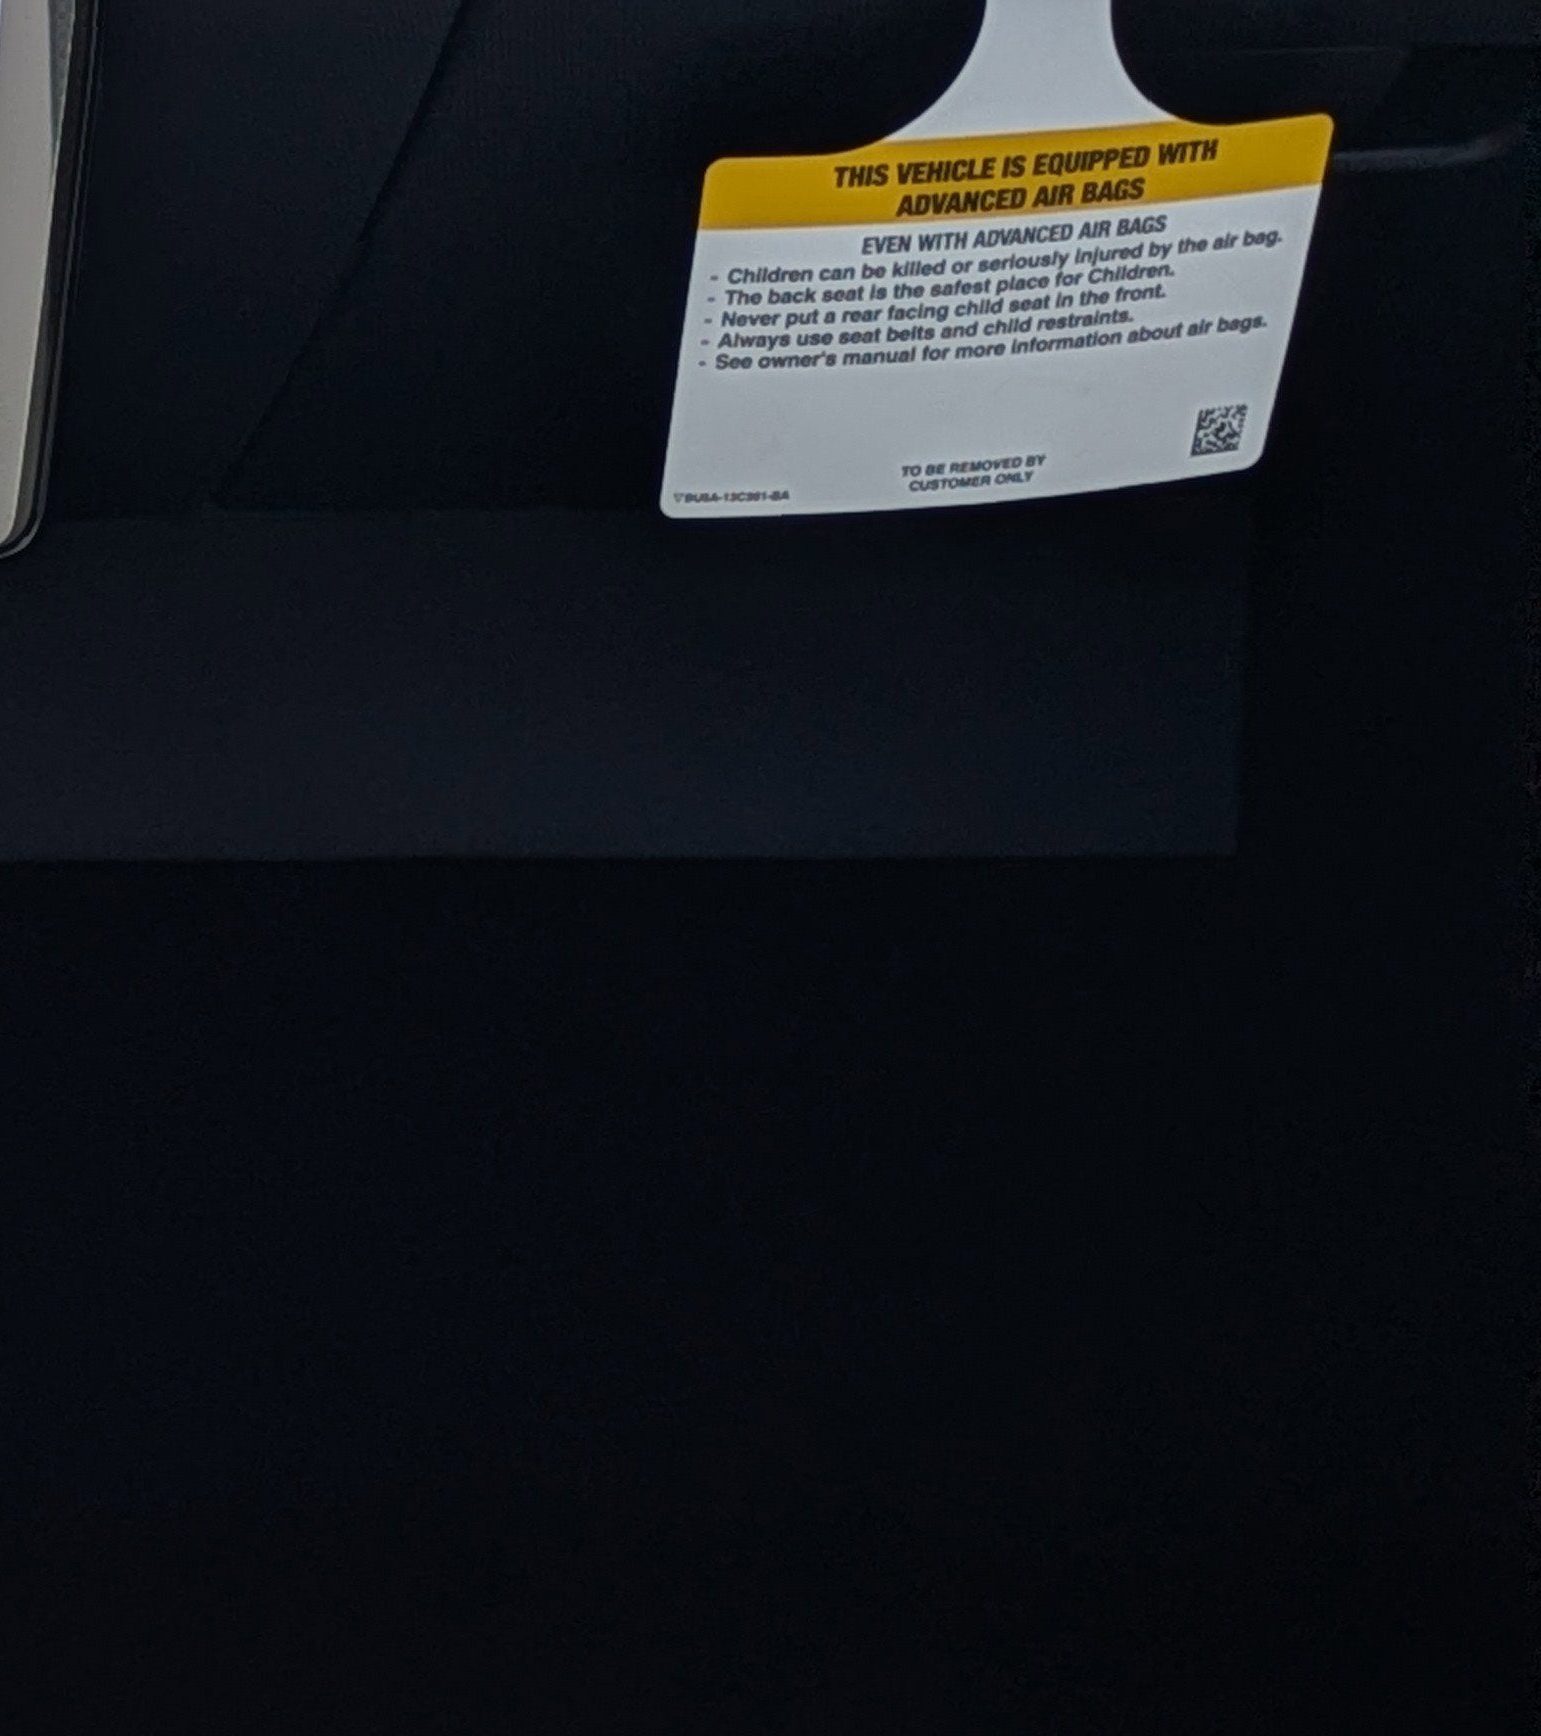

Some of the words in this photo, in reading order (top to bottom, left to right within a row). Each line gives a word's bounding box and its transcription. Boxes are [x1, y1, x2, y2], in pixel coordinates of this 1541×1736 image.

[834, 163, 889, 188] THIS
[897, 157, 997, 184] VEHICLE
[1002, 155, 1026, 178] IS
[1032, 145, 1151, 176] EQUIPPED
[1158, 139, 1219, 165] WITH
[896, 188, 1027, 217] ADVANCED
[1032, 183, 1075, 207] AIR
[1081, 177, 1145, 203] BAGS
[862, 235, 912, 255] EVEN
[918, 231, 969, 251] WITH
[973, 222, 1074, 248] ADVANCED
[1078, 220, 1111, 240] AIR
[1116, 215, 1167, 237] BAGS
[727, 267, 813, 285] Children
[819, 266, 855, 281] can
[861, 263, 886, 279] be
[892, 258, 946, 277] killed
[951, 260, 973, 274] or
[978, 250, 1069, 273] seriously
[1074, 242, 1143, 266] injured
[1148, 241, 1172, 259] by
[1178, 236, 1208, 254] the
[1213, 233, 1238, 251] air
[1242, 229, 1282, 248] bag.
[721, 311, 781, 327] Never
[784, 309, 818, 328] put
[824, 310, 836, 324] a
[841, 309, 882, 323] rear
[887, 304, 949, 322] facing
[954, 298, 1004, 317] child
[1009, 294, 1050, 313] seat
[1055, 292, 1074, 308] in
[1079, 289, 1110, 307] the
[1114, 283, 1165, 303] front.
[725, 289, 763, 306] The
[768, 288, 817, 304] back
[822, 286, 864, 303] seat
[870, 284, 887, 300] is
[894, 282, 925, 299] the
[930, 279, 991, 297] safest
[996, 275, 1050, 295] place
[1055, 271, 1083, 288] for
[1088, 262, 1175, 284] Children.
[715, 353, 753, 370] See
[758, 351, 837, 368] owner's
[842, 347, 916, 366] manual
[922, 344, 950, 361] for
[954, 342, 1005, 359] more
[1011, 328, 1122, 353] information
[1127, 322, 1184, 344] about
[1186, 320, 1214, 336] air
[1217, 314, 1267, 335] bags.
[718, 332, 791, 351] Always
[797, 332, 833, 346] use
[838, 327, 881, 345] seat
[886, 325, 935, 343] belts
[941, 321, 978, 338] and
[983, 316, 1032, 336] child
[1037, 309, 1134, 330] restraints.
[901, 465, 921, 477] TO
[925, 463, 946, 476] BE
[949, 456, 1022, 475] REMOVED
[1025, 453, 1047, 468] BY
[908, 474, 992, 493] CUSTOMER
[995, 470, 1034, 486] ONLY
